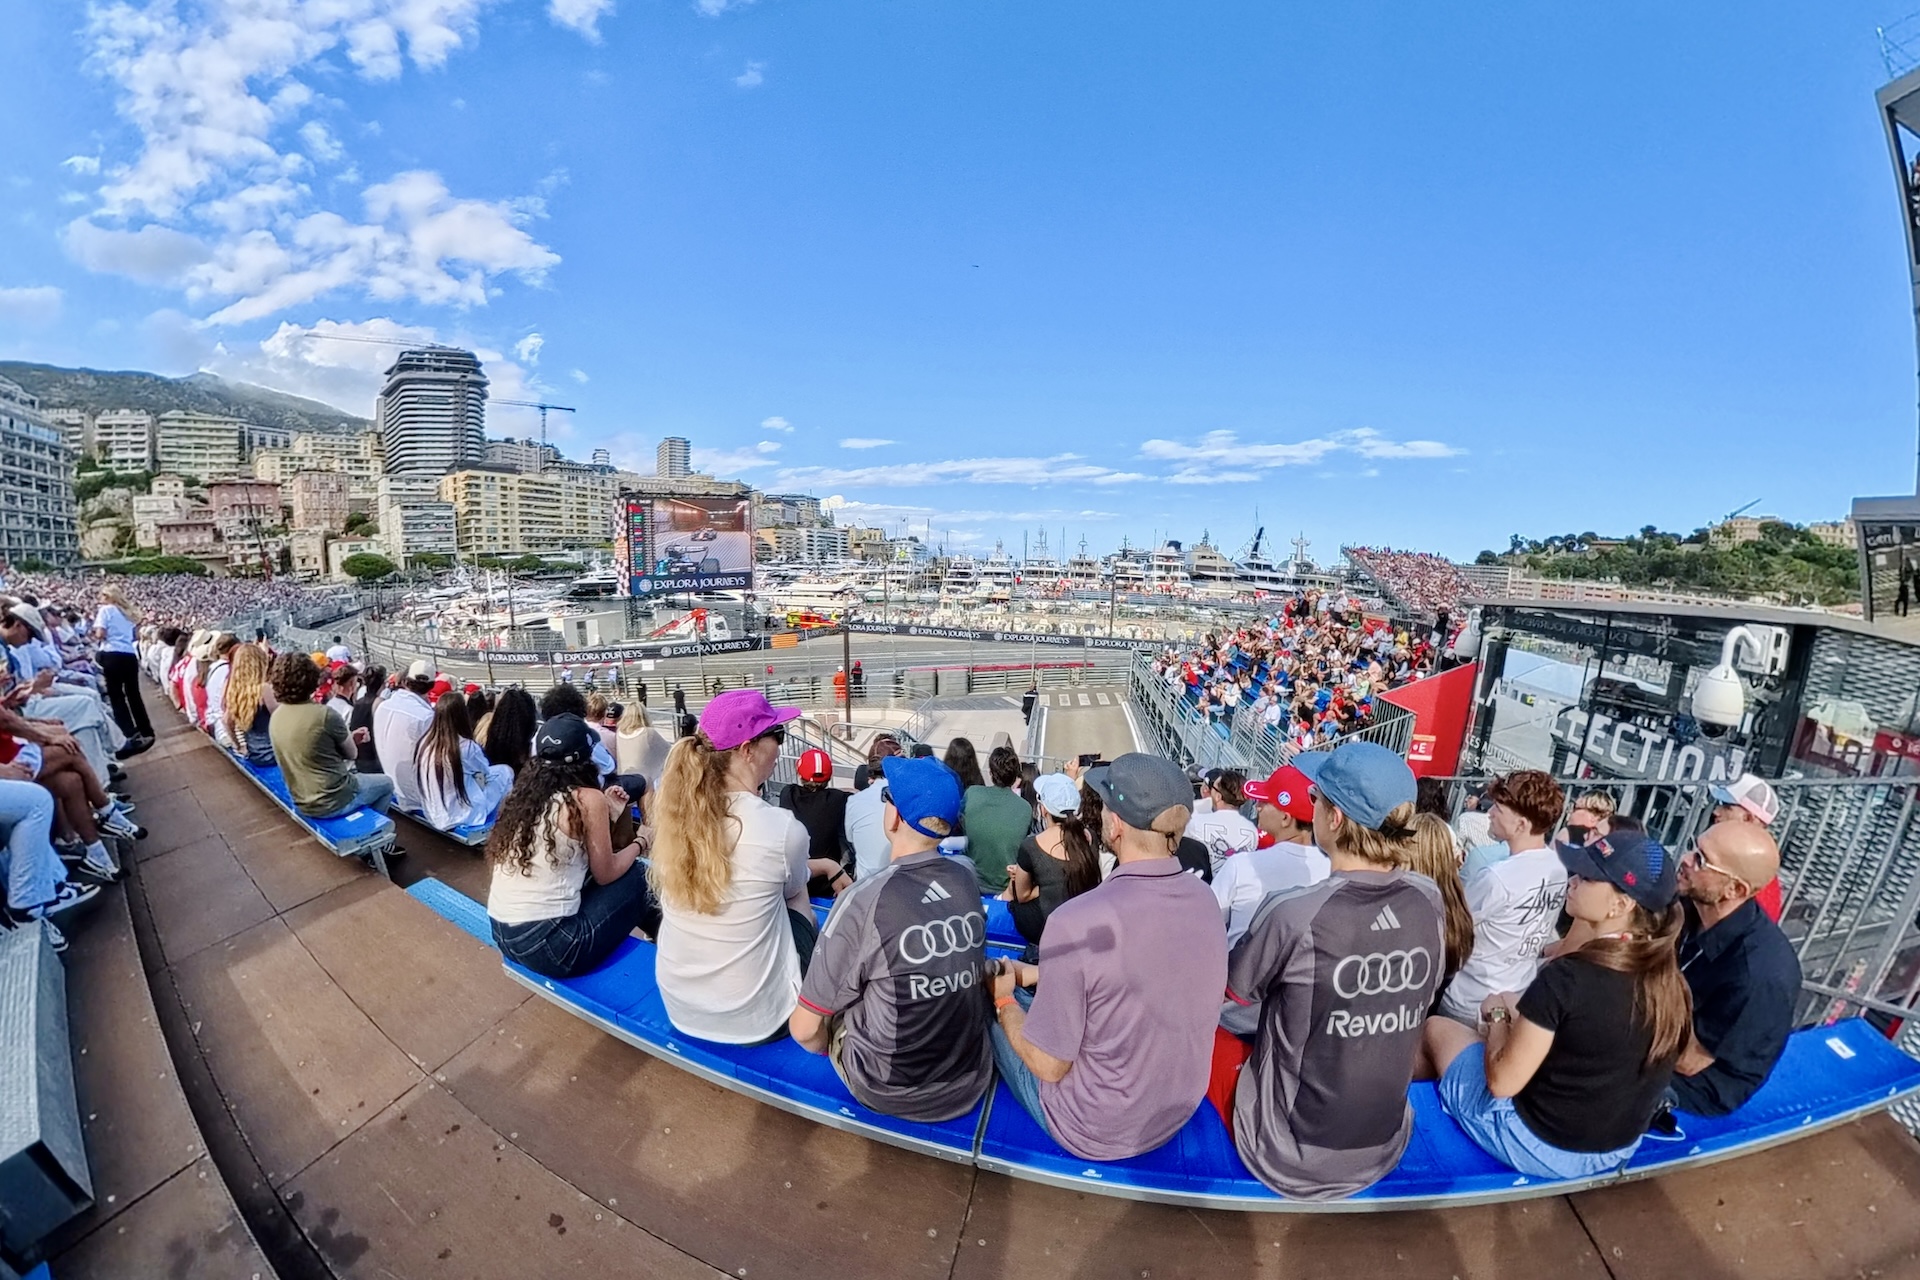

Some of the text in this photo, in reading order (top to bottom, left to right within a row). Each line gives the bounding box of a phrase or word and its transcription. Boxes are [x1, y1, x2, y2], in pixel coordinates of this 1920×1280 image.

[654, 576, 746, 590] EXPLORA JOURNEYS
[918, 627, 981, 640] EXPLORA JOURNEYS
[1003, 632, 1071, 645] EXPLORA JOURNEYS
[672, 640, 751, 655] EXPLORA JOURNEYS
[1094, 639, 1127, 648] EXPLORA
[564, 651, 600, 663] EXPLORA
[1465, 733, 1480, 749] LES
[1461, 750, 1473, 764] DE
[1326, 1001, 1424, 1038] Revolut
